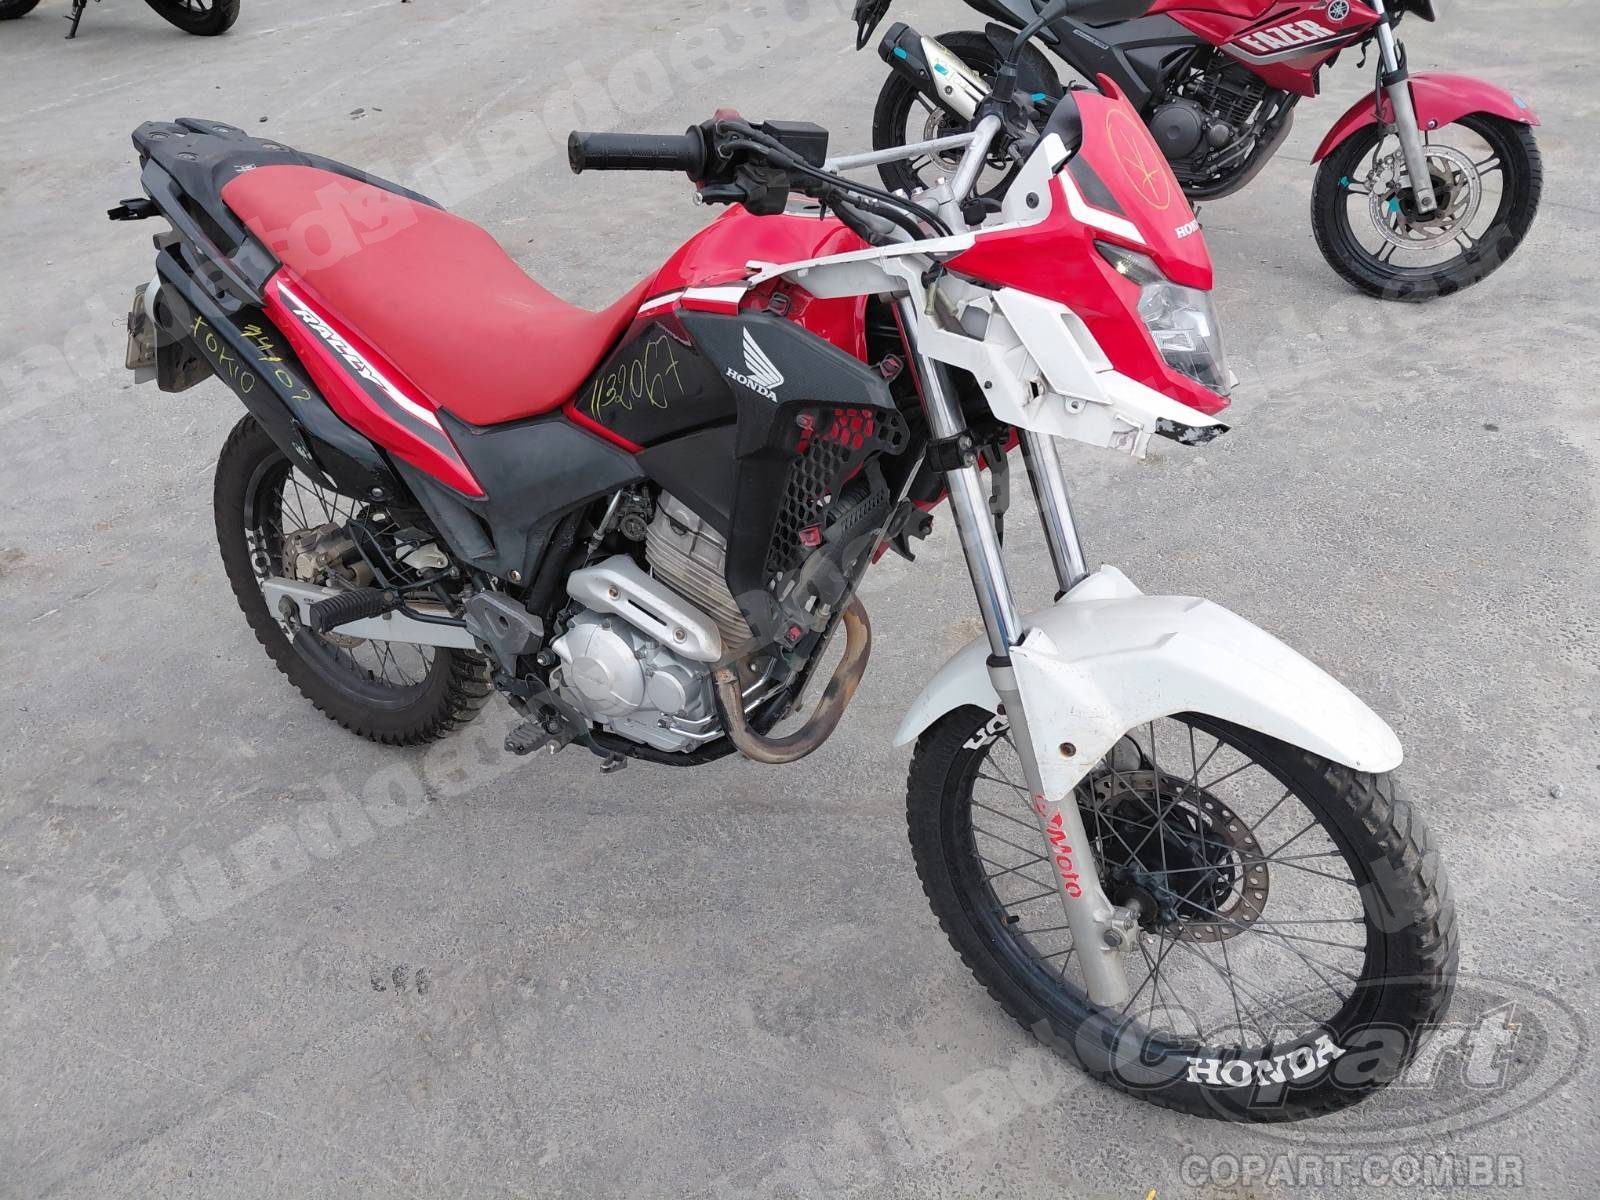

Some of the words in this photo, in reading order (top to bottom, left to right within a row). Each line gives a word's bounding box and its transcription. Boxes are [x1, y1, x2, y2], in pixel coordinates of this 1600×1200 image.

[1239, 18, 1337, 52] FAZER
[292, 308, 391, 393] RALLY
[725, 366, 778, 403] HONDA
[1186, 1034, 1347, 1087] HONDA
